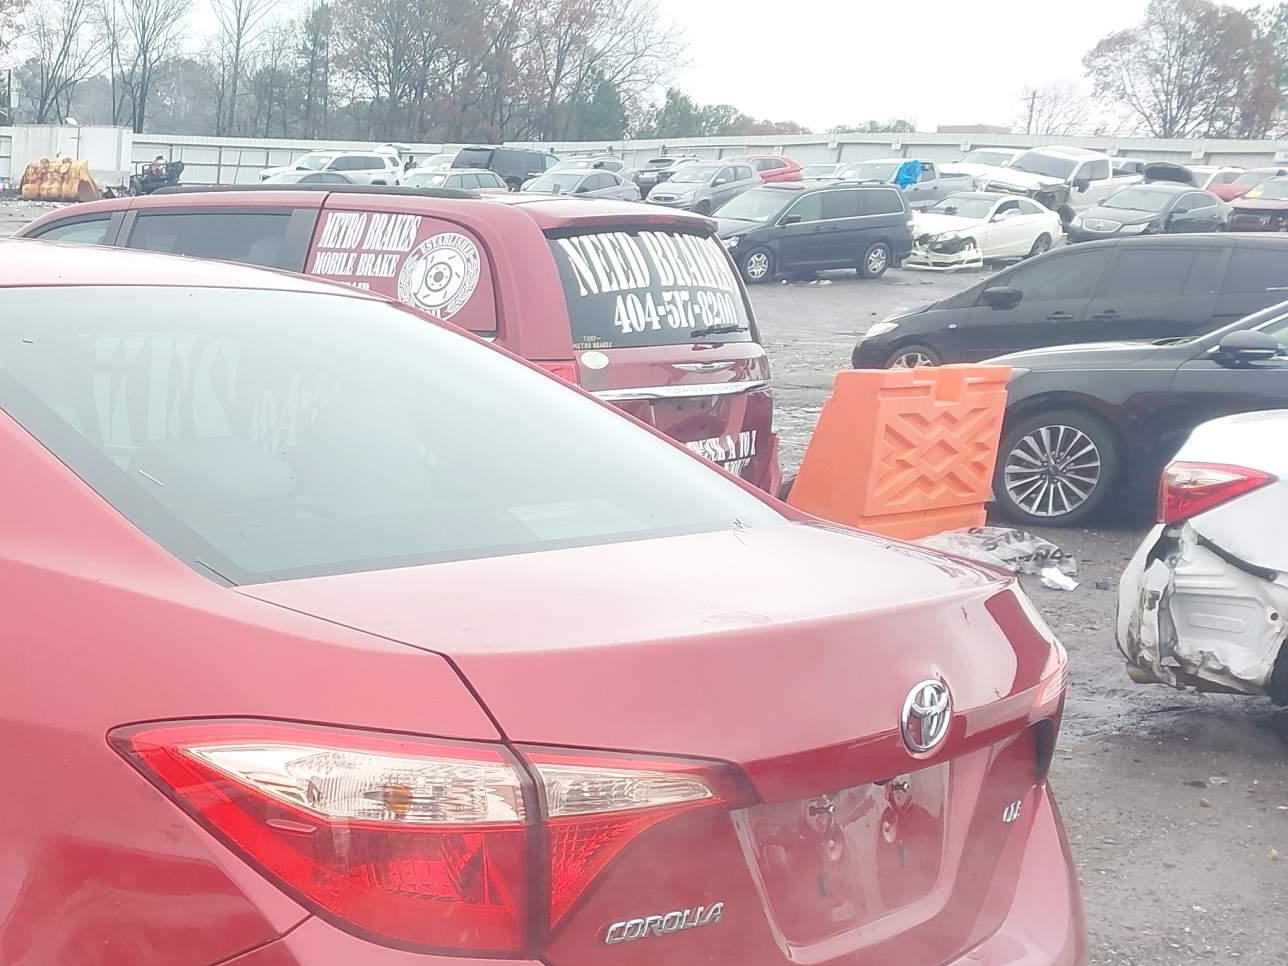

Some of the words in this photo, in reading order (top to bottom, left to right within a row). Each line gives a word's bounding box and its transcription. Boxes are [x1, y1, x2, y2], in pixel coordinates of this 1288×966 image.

[317, 212, 368, 249] METRO
[362, 213, 423, 252] BRAKES
[311, 251, 358, 275] MOBILE
[355, 253, 401, 278] BRAKE
[556, 231, 651, 297] NEED
[614, 290, 739, 334] 404-517-8200
[605, 901, 725, 945] COROLLA
